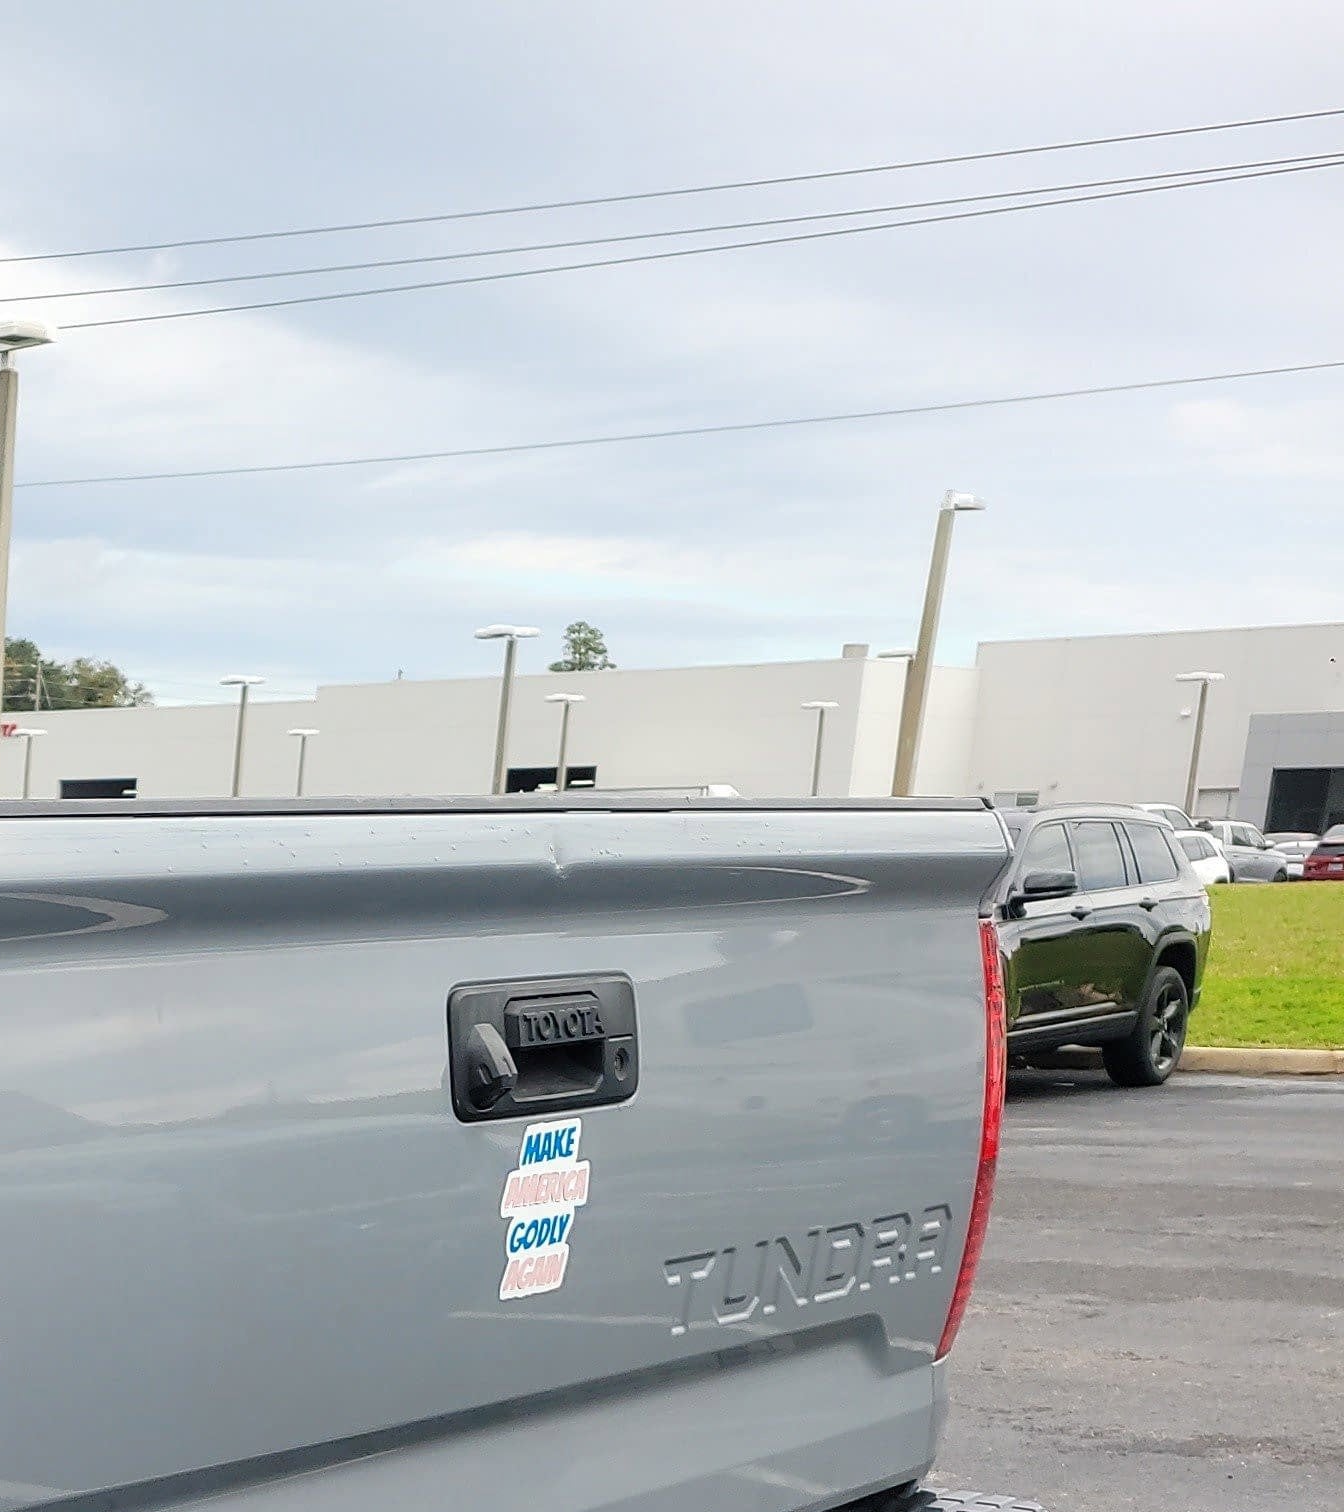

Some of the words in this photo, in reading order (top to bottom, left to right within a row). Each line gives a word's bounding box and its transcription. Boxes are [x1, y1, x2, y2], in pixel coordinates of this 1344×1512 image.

[521, 1005, 606, 1043] TOYOTA
[522, 1126, 577, 1165] MAKE
[504, 1168, 587, 1209] AMERICA
[510, 1213, 571, 1253] GODLY
[503, 1252, 565, 1292] AGAIN
[663, 1202, 953, 1337] TUNDRA
